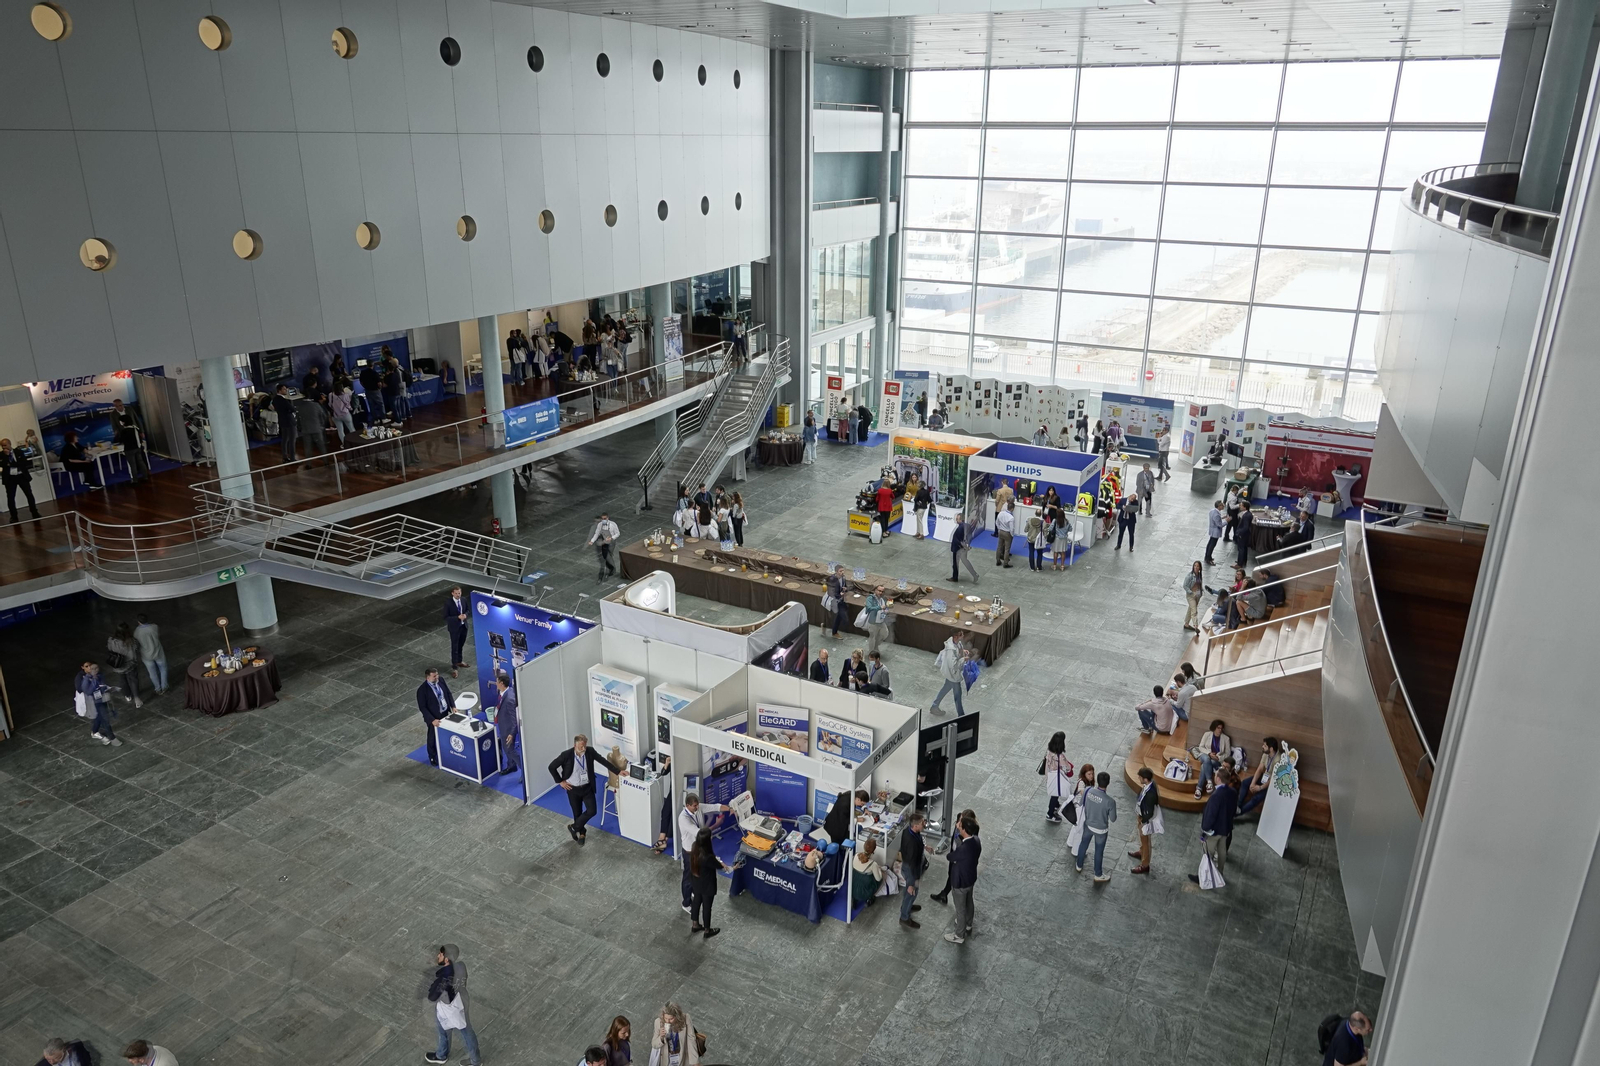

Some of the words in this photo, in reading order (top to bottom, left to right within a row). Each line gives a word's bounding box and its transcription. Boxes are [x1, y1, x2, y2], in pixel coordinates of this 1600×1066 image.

[50, 392, 82, 403] equilibrio
[83, 387, 112, 398] perfecto
[1006, 464, 1042, 477] PHILIPS
[850, 519, 869, 527] stryker
[534, 618, 553, 630] Family
[604, 699, 619, 708] SABES
[760, 716, 797, 727] EleGARD
[818, 717, 848, 733] ResQCPR
[849, 727, 871, 740] System
[856, 741, 870, 750] 49%
[873, 750, 881, 765] IES
[881, 731, 903, 757] MEDICAL
[732, 740, 745, 752] IES
[746, 744, 787, 765] MEDICAL
[623, 779, 646, 791] Baxter
[754, 869, 766, 879] IES
[765, 873, 797, 892] MEDICAL
